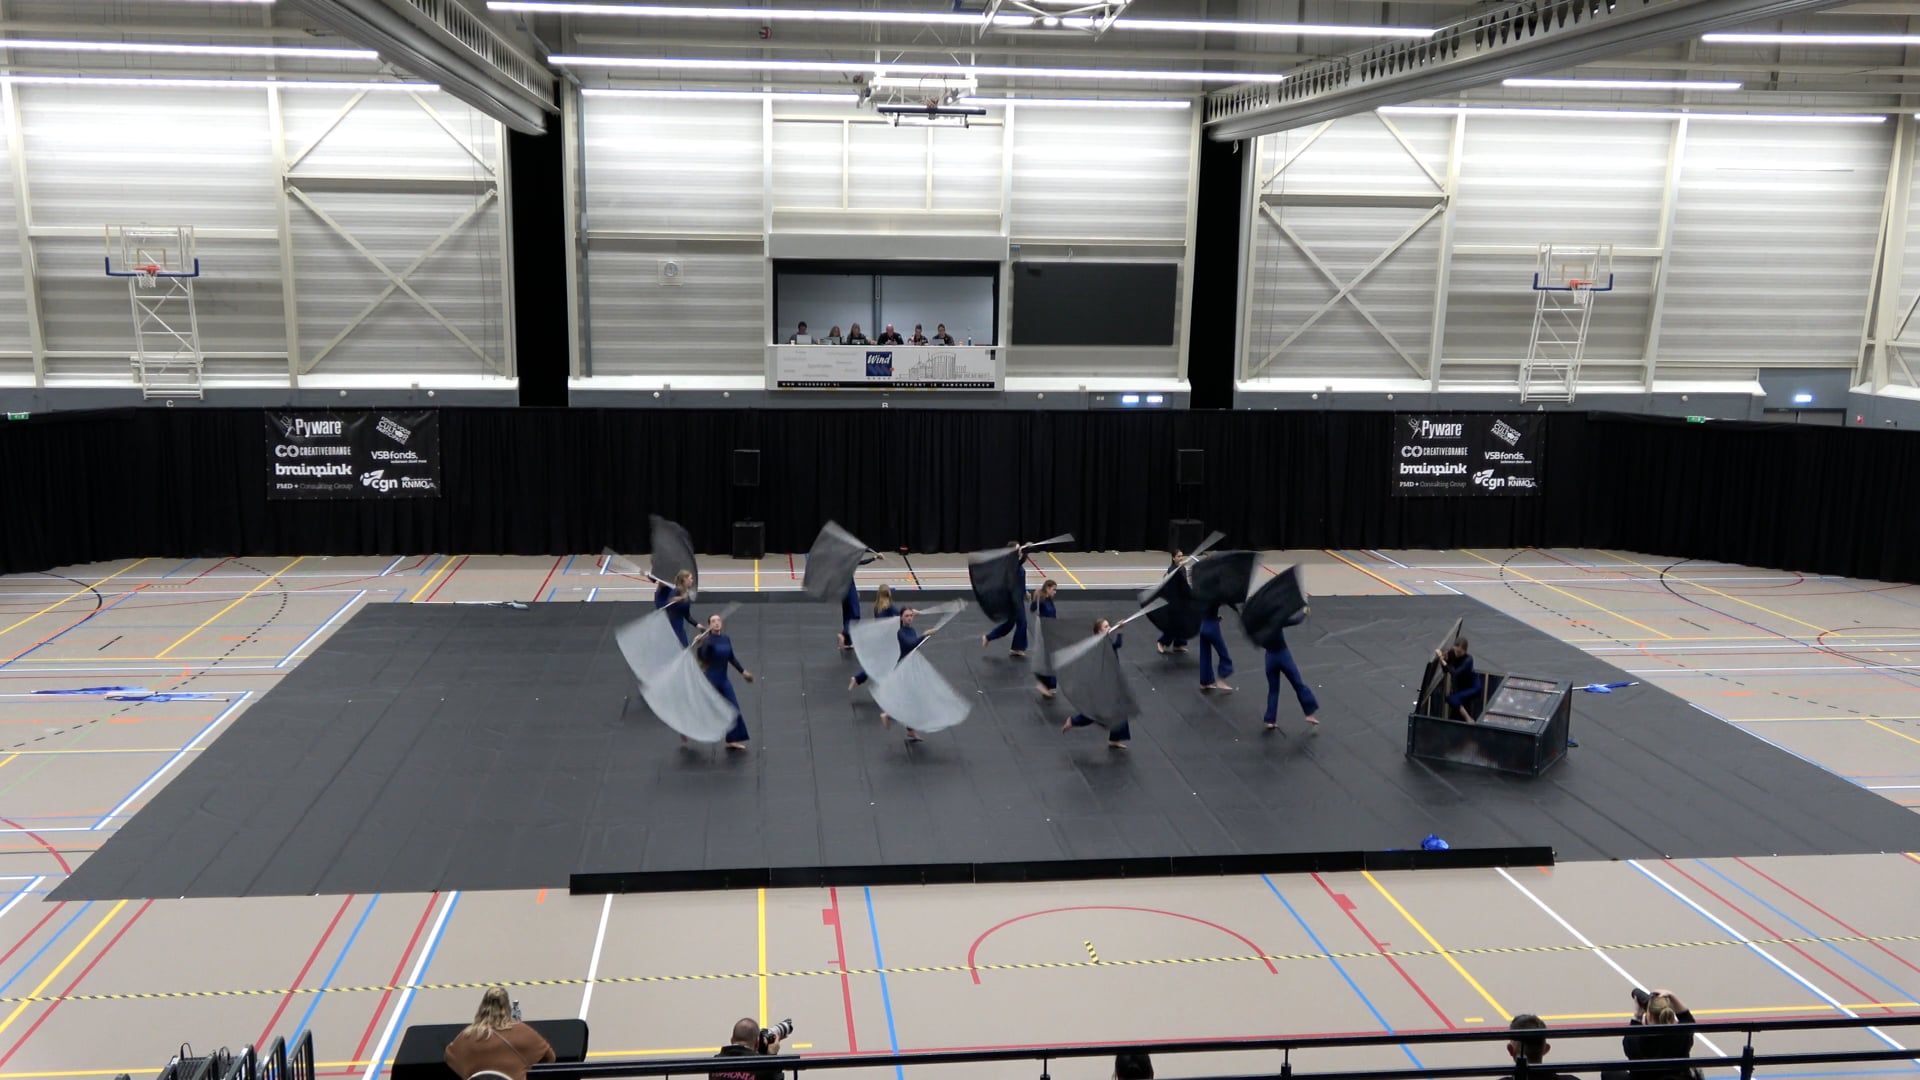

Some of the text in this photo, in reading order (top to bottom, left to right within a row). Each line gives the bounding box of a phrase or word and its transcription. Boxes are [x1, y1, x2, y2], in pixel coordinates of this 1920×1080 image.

[867, 354, 892, 365] Wind
[295, 418, 342, 438] Pyware
[1421, 420, 1462, 439] Pyware
[300, 446, 351, 456] CREATIVEORANGE
[1423, 447, 1468, 456] CREATIVEORANGE
[275, 463, 352, 478] brainpink
[1400, 462, 1467, 476] brainpink
[371, 479, 398, 492] cgn
[1482, 477, 1505, 490] cgn
